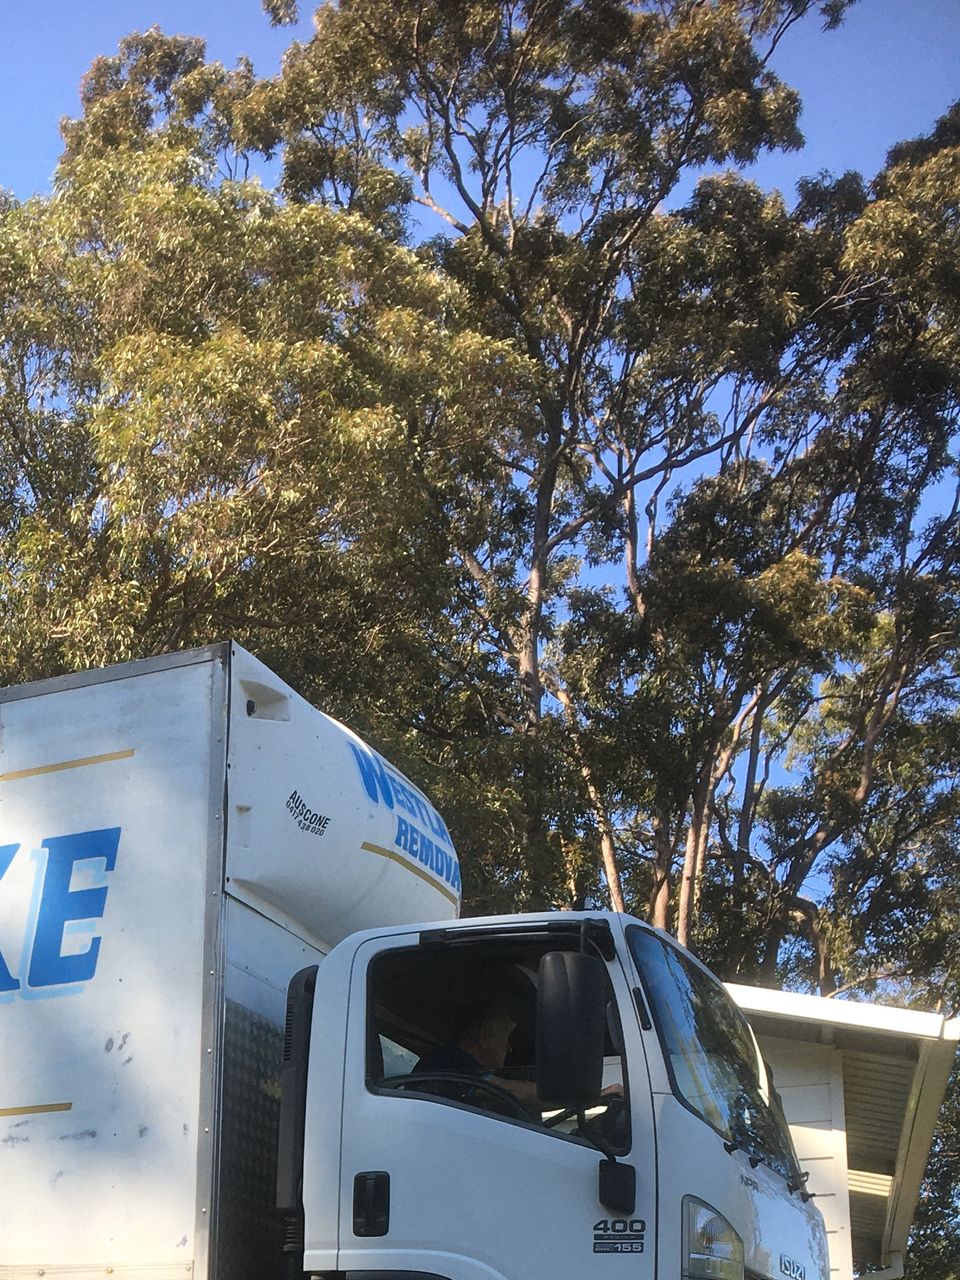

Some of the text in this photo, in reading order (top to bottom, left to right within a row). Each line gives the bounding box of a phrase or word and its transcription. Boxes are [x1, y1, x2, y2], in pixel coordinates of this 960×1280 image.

[289, 790, 331, 829] AUSCONE
[310, 826, 325, 837] 020
[592, 1219, 646, 1233] 400
[614, 1243, 642, 1252] 155
